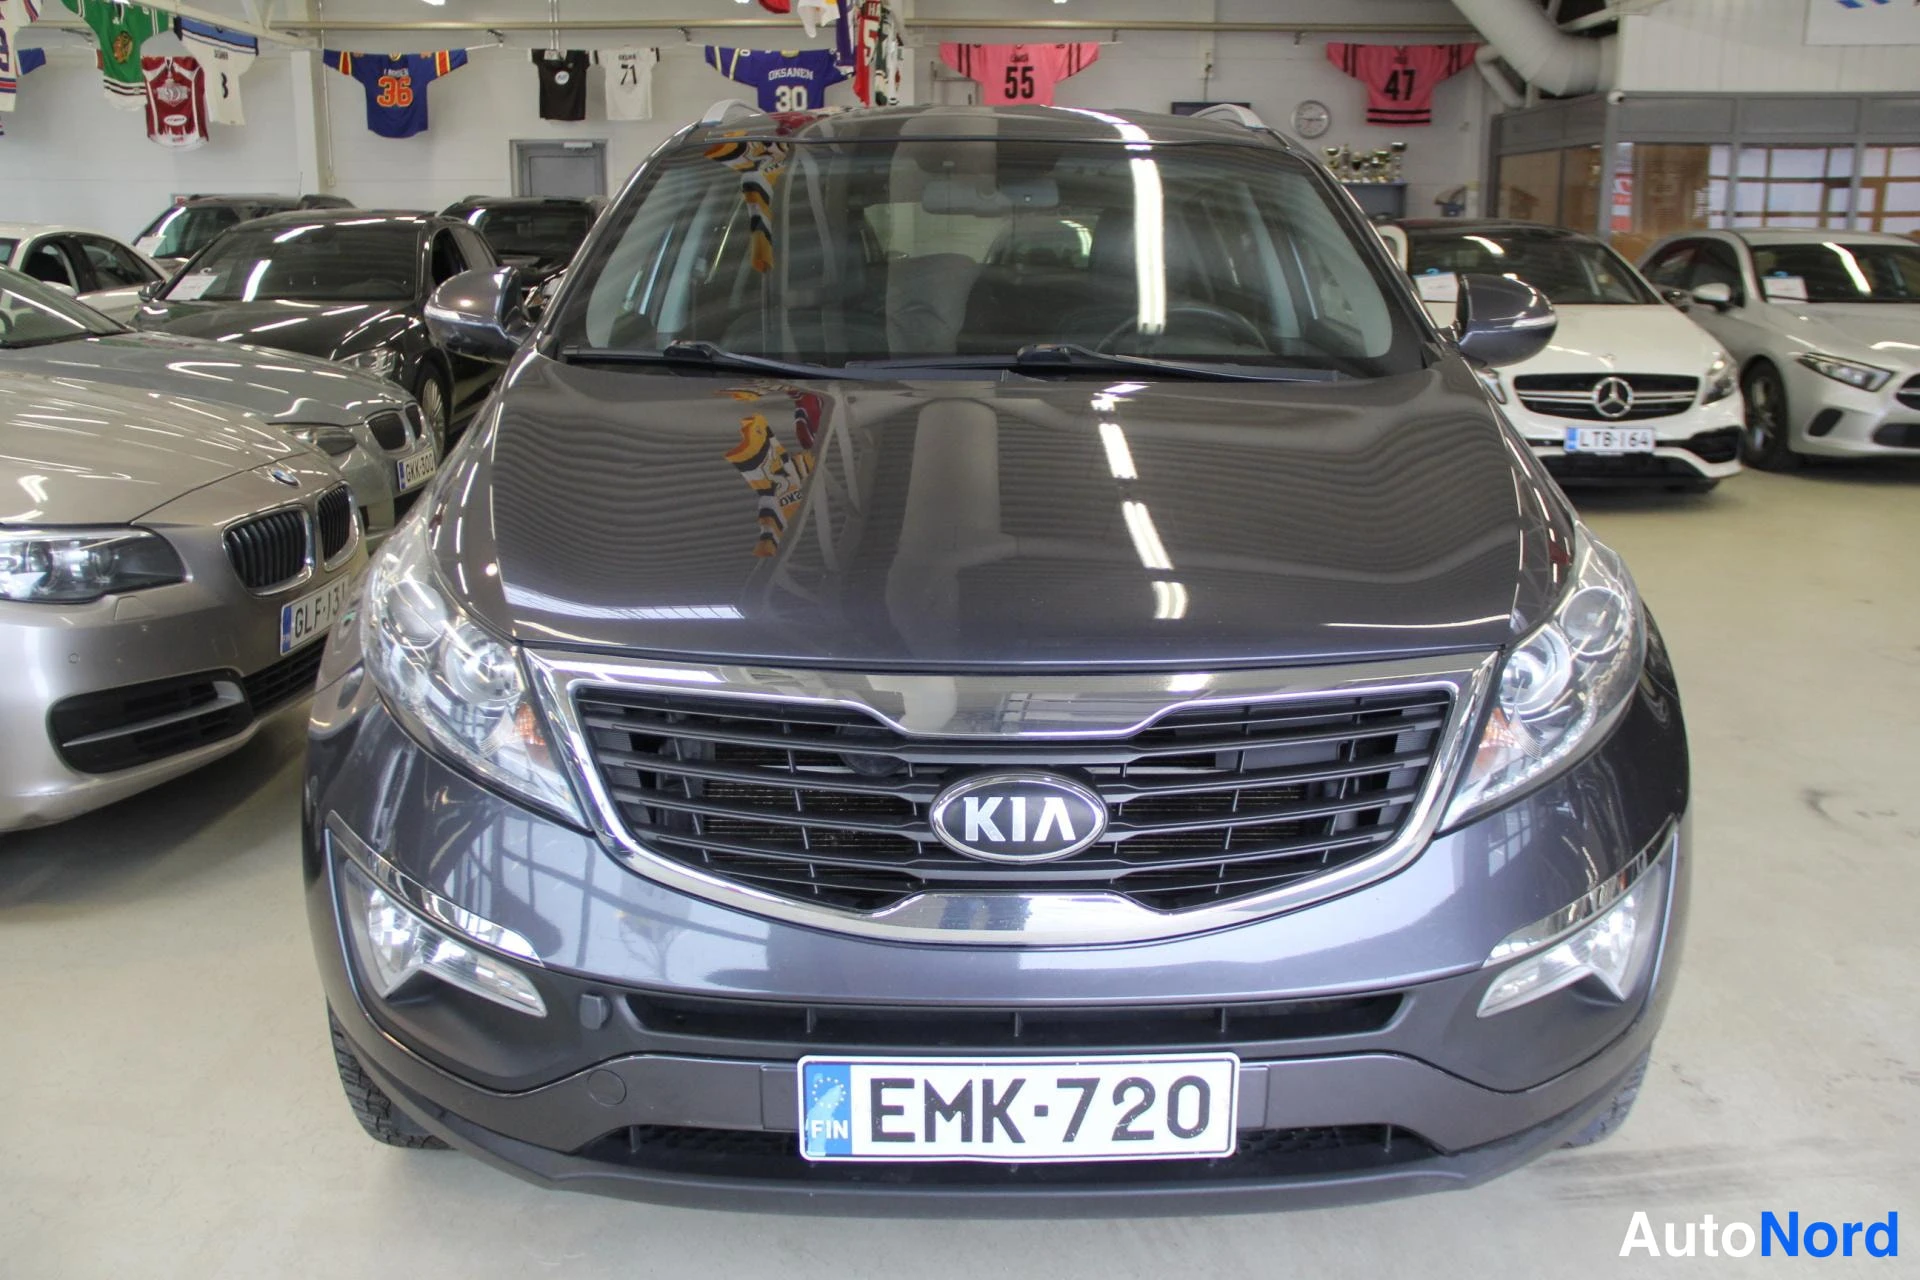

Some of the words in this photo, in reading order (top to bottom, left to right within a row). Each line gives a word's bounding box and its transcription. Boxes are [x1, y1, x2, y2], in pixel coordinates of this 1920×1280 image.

[621, 64, 637, 85] 71
[768, 67, 814, 81] OKSANEN
[1004, 66, 1034, 99] 55
[1384, 69, 1416, 101] 47
[377, 75, 413, 107] 36
[776, 85, 808, 112] 30
[1580, 431, 1649, 448] LTB-164
[963, 796, 1077, 842] KIA
[869, 1075, 1211, 1144] EMK-720
[811, 1119, 849, 1140] FIN
